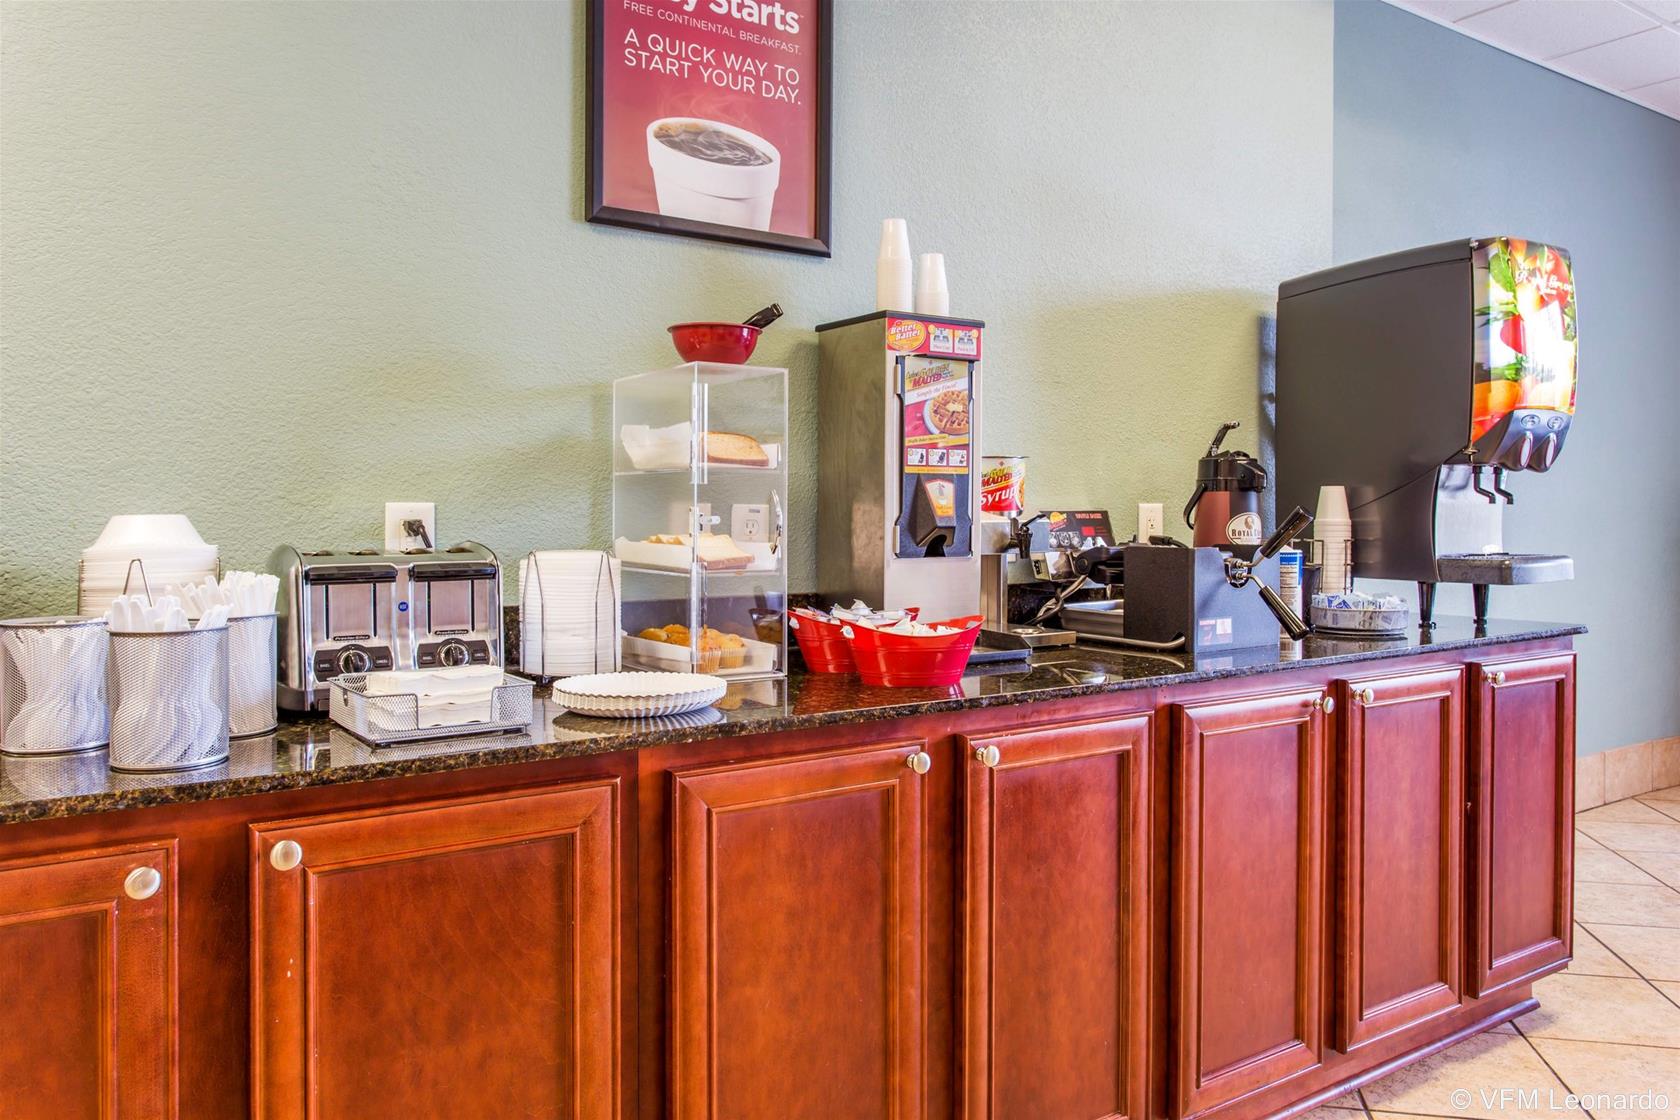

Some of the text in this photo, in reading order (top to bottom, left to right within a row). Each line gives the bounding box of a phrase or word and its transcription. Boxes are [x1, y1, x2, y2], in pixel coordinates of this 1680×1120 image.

[624, 1, 654, 17] FREE
[657, 9, 736, 38] CONTINENTAL
[708, 0, 800, 35] Starts
[624, 28, 800, 86] A QUICK WAY TO
[624, 48, 801, 105] START YOUR DAY.
